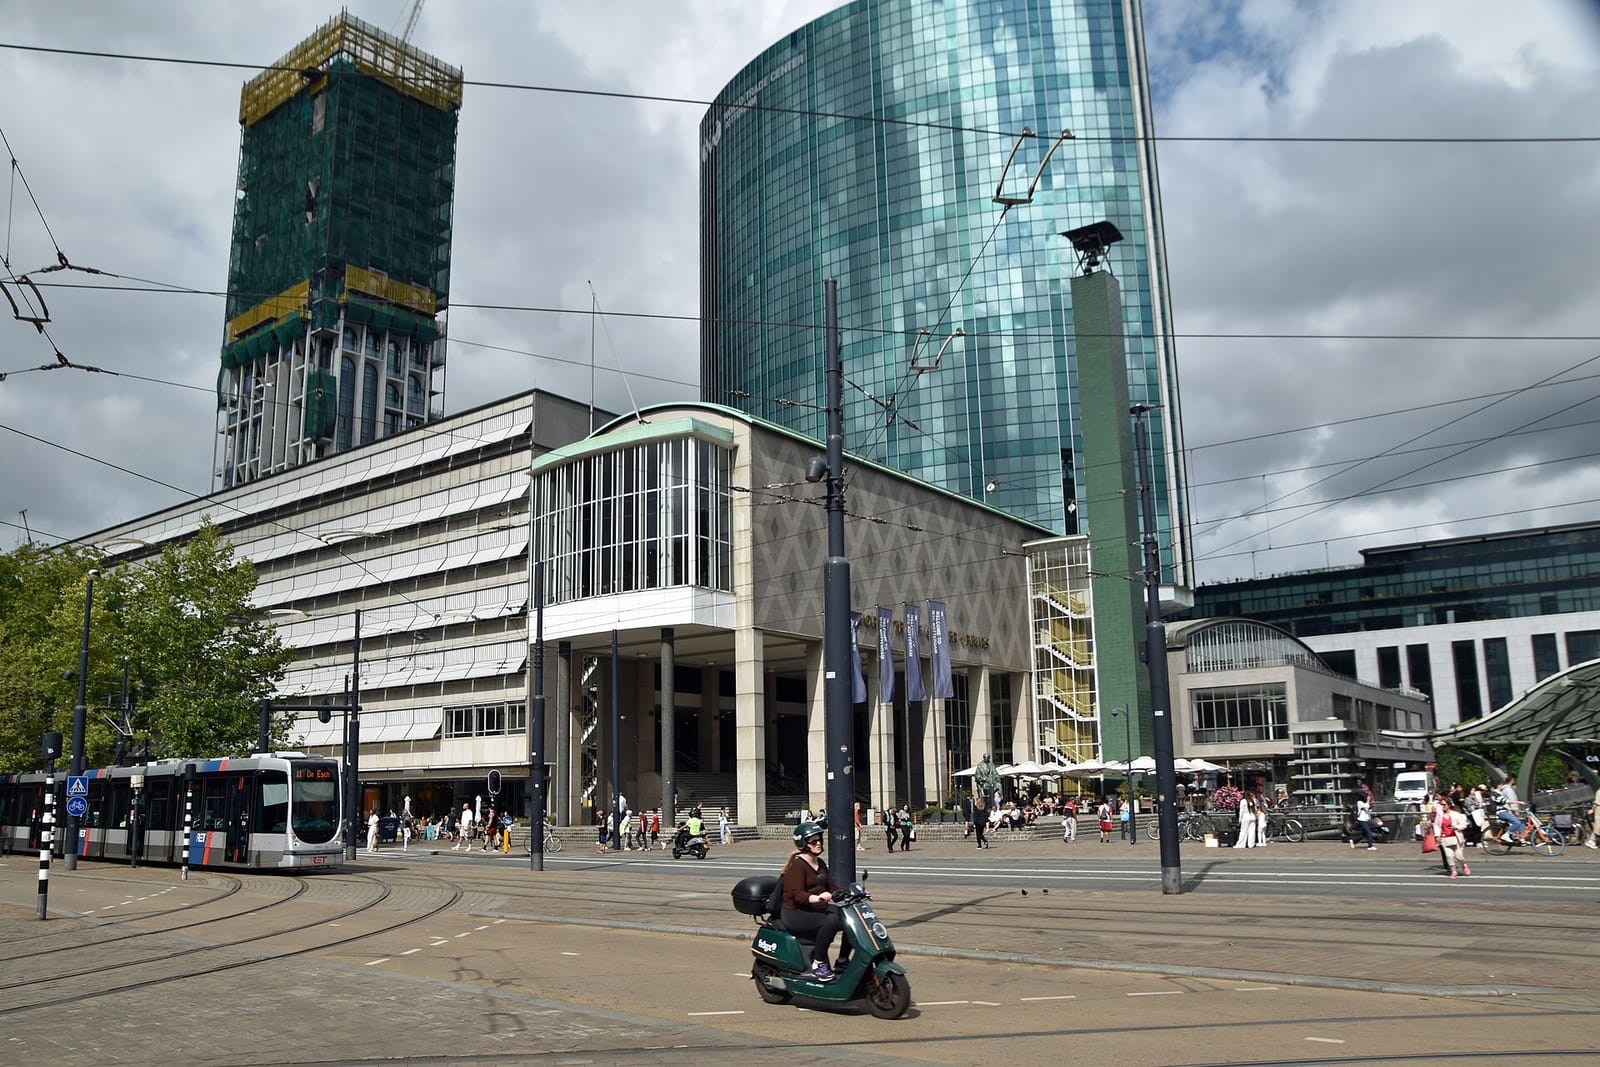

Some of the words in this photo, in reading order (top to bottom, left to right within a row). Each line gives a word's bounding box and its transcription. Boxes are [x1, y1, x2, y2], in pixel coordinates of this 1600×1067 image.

[745, 75, 769, 100] TRADE
[771, 54, 804, 82] CENTER
[296, 770, 302, 778] 11
[306, 770, 314, 778] De
[316, 770, 331, 778] Esch
[196, 832, 207, 842] RET
[312, 855, 328, 864] RET
